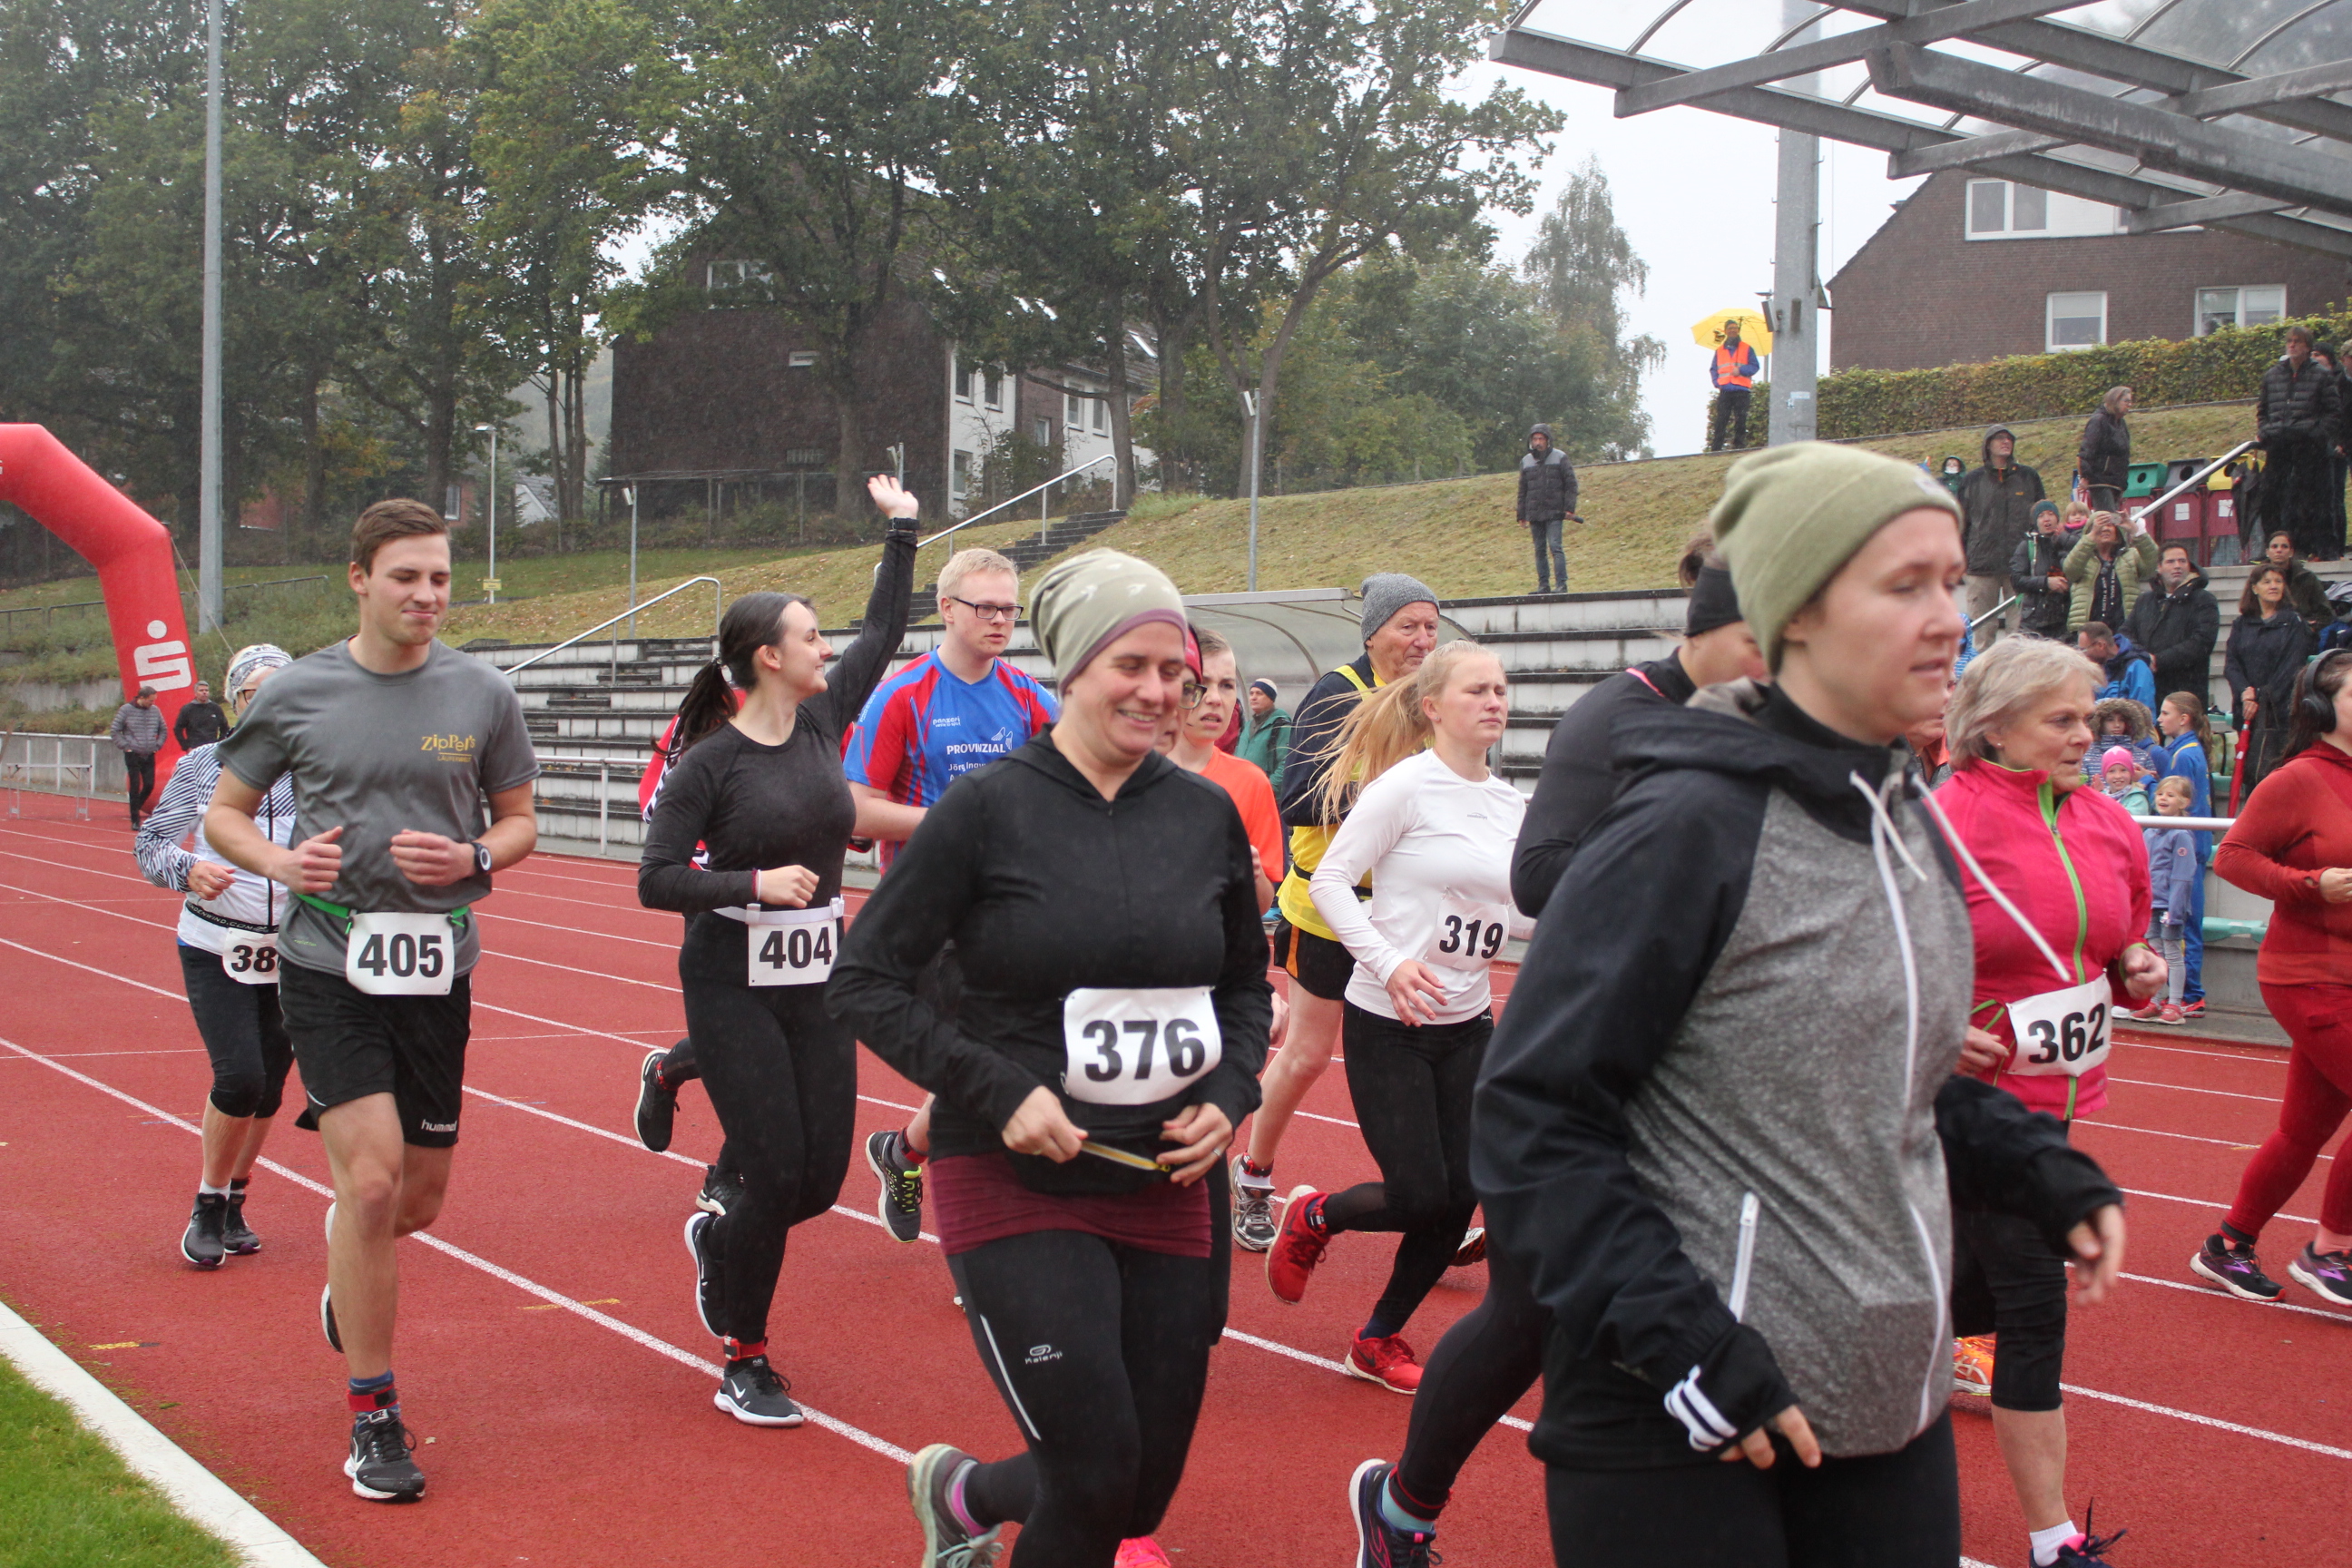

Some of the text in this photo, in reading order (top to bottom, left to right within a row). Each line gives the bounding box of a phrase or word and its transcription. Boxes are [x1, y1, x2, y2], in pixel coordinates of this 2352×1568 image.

[933, 716, 960, 725] panzeri
[946, 743, 1006, 755] PROVINZIAL
[948, 763, 965, 772] Jörg
[760, 926, 832, 969] 404
[1439, 915, 1504, 959] 319
[231, 945, 279, 972] 38
[358, 933, 444, 978] 405
[1083, 1018, 1206, 1083] 376
[2028, 1003, 2105, 1063] 362
[421, 1119, 457, 1132] hummel
